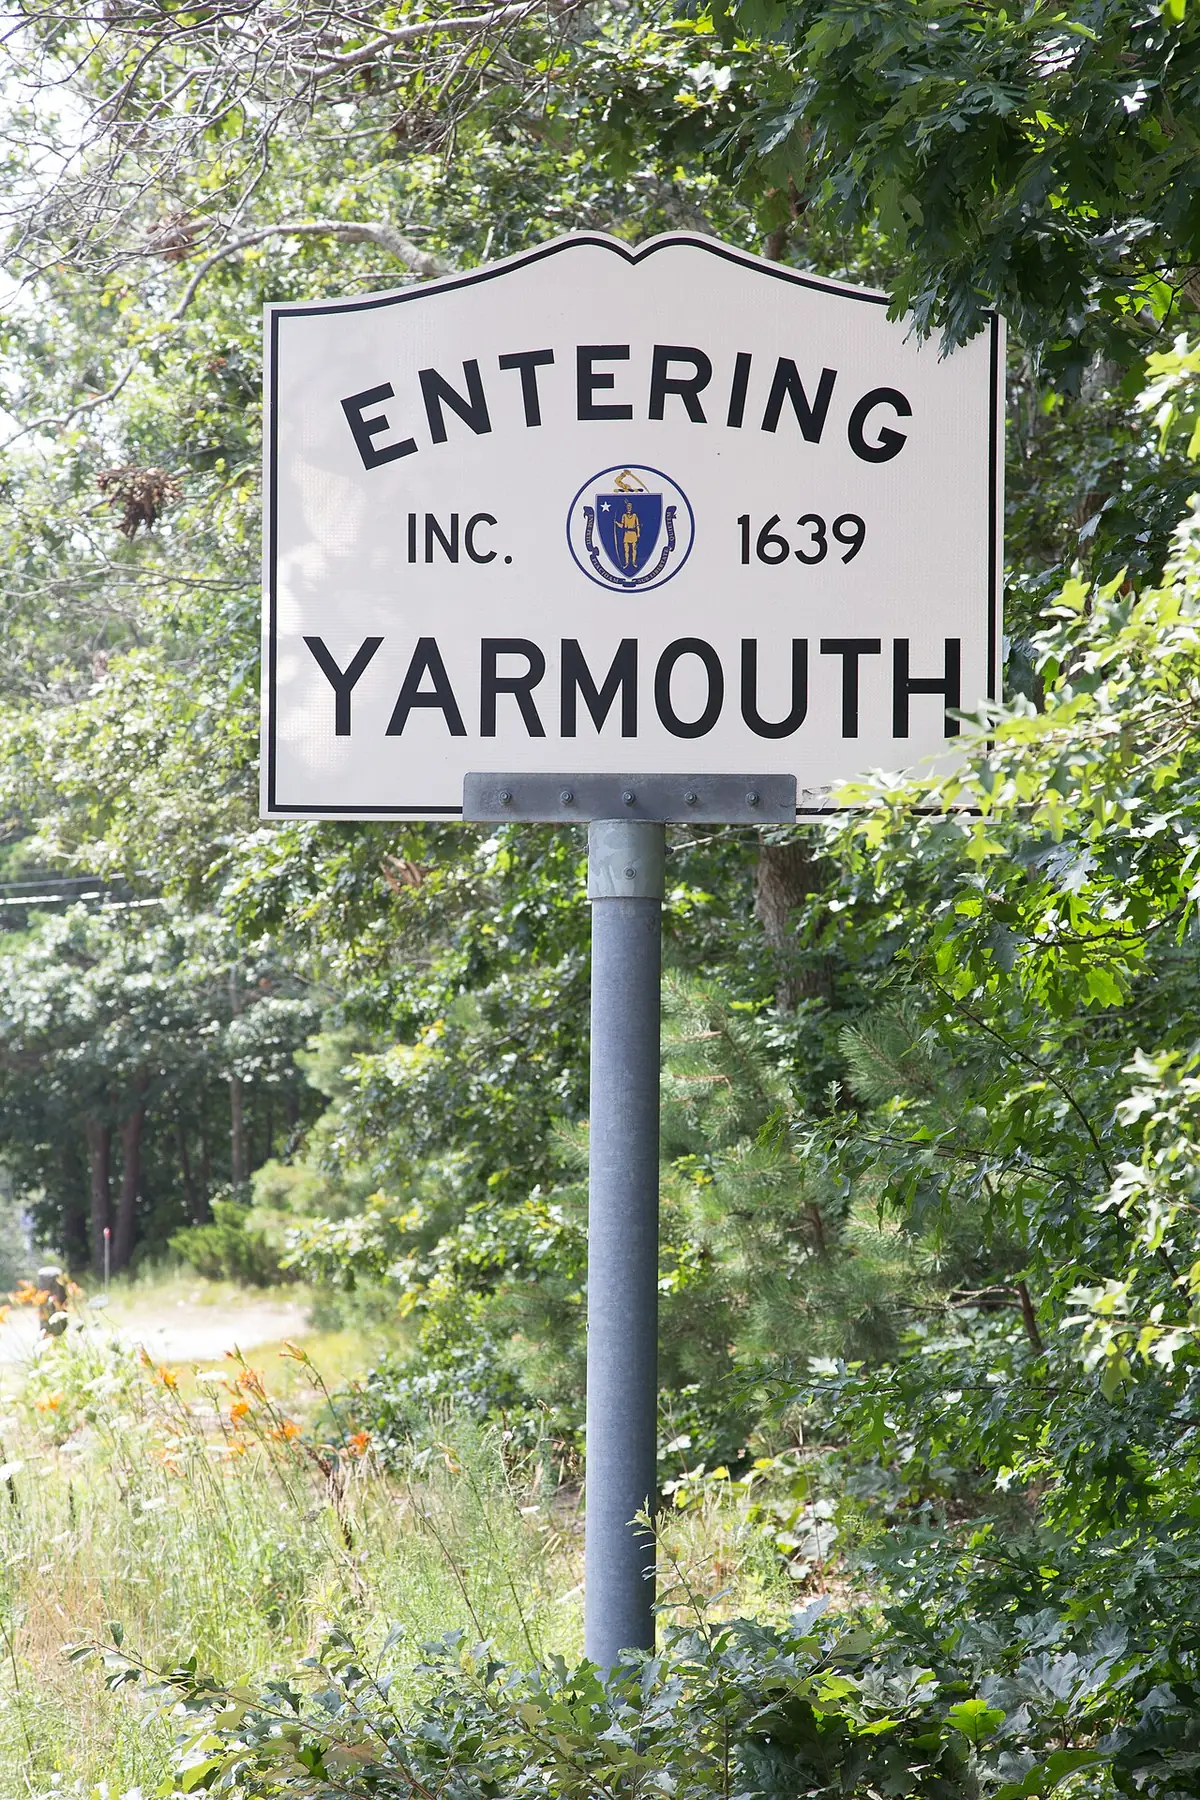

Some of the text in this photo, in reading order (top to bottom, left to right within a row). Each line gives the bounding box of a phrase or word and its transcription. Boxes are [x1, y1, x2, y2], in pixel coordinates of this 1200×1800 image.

[340, 344, 913, 471] ENTERING
[408, 512, 866, 565] INC. 1639
[302, 636, 961, 740] YARMOUTH
